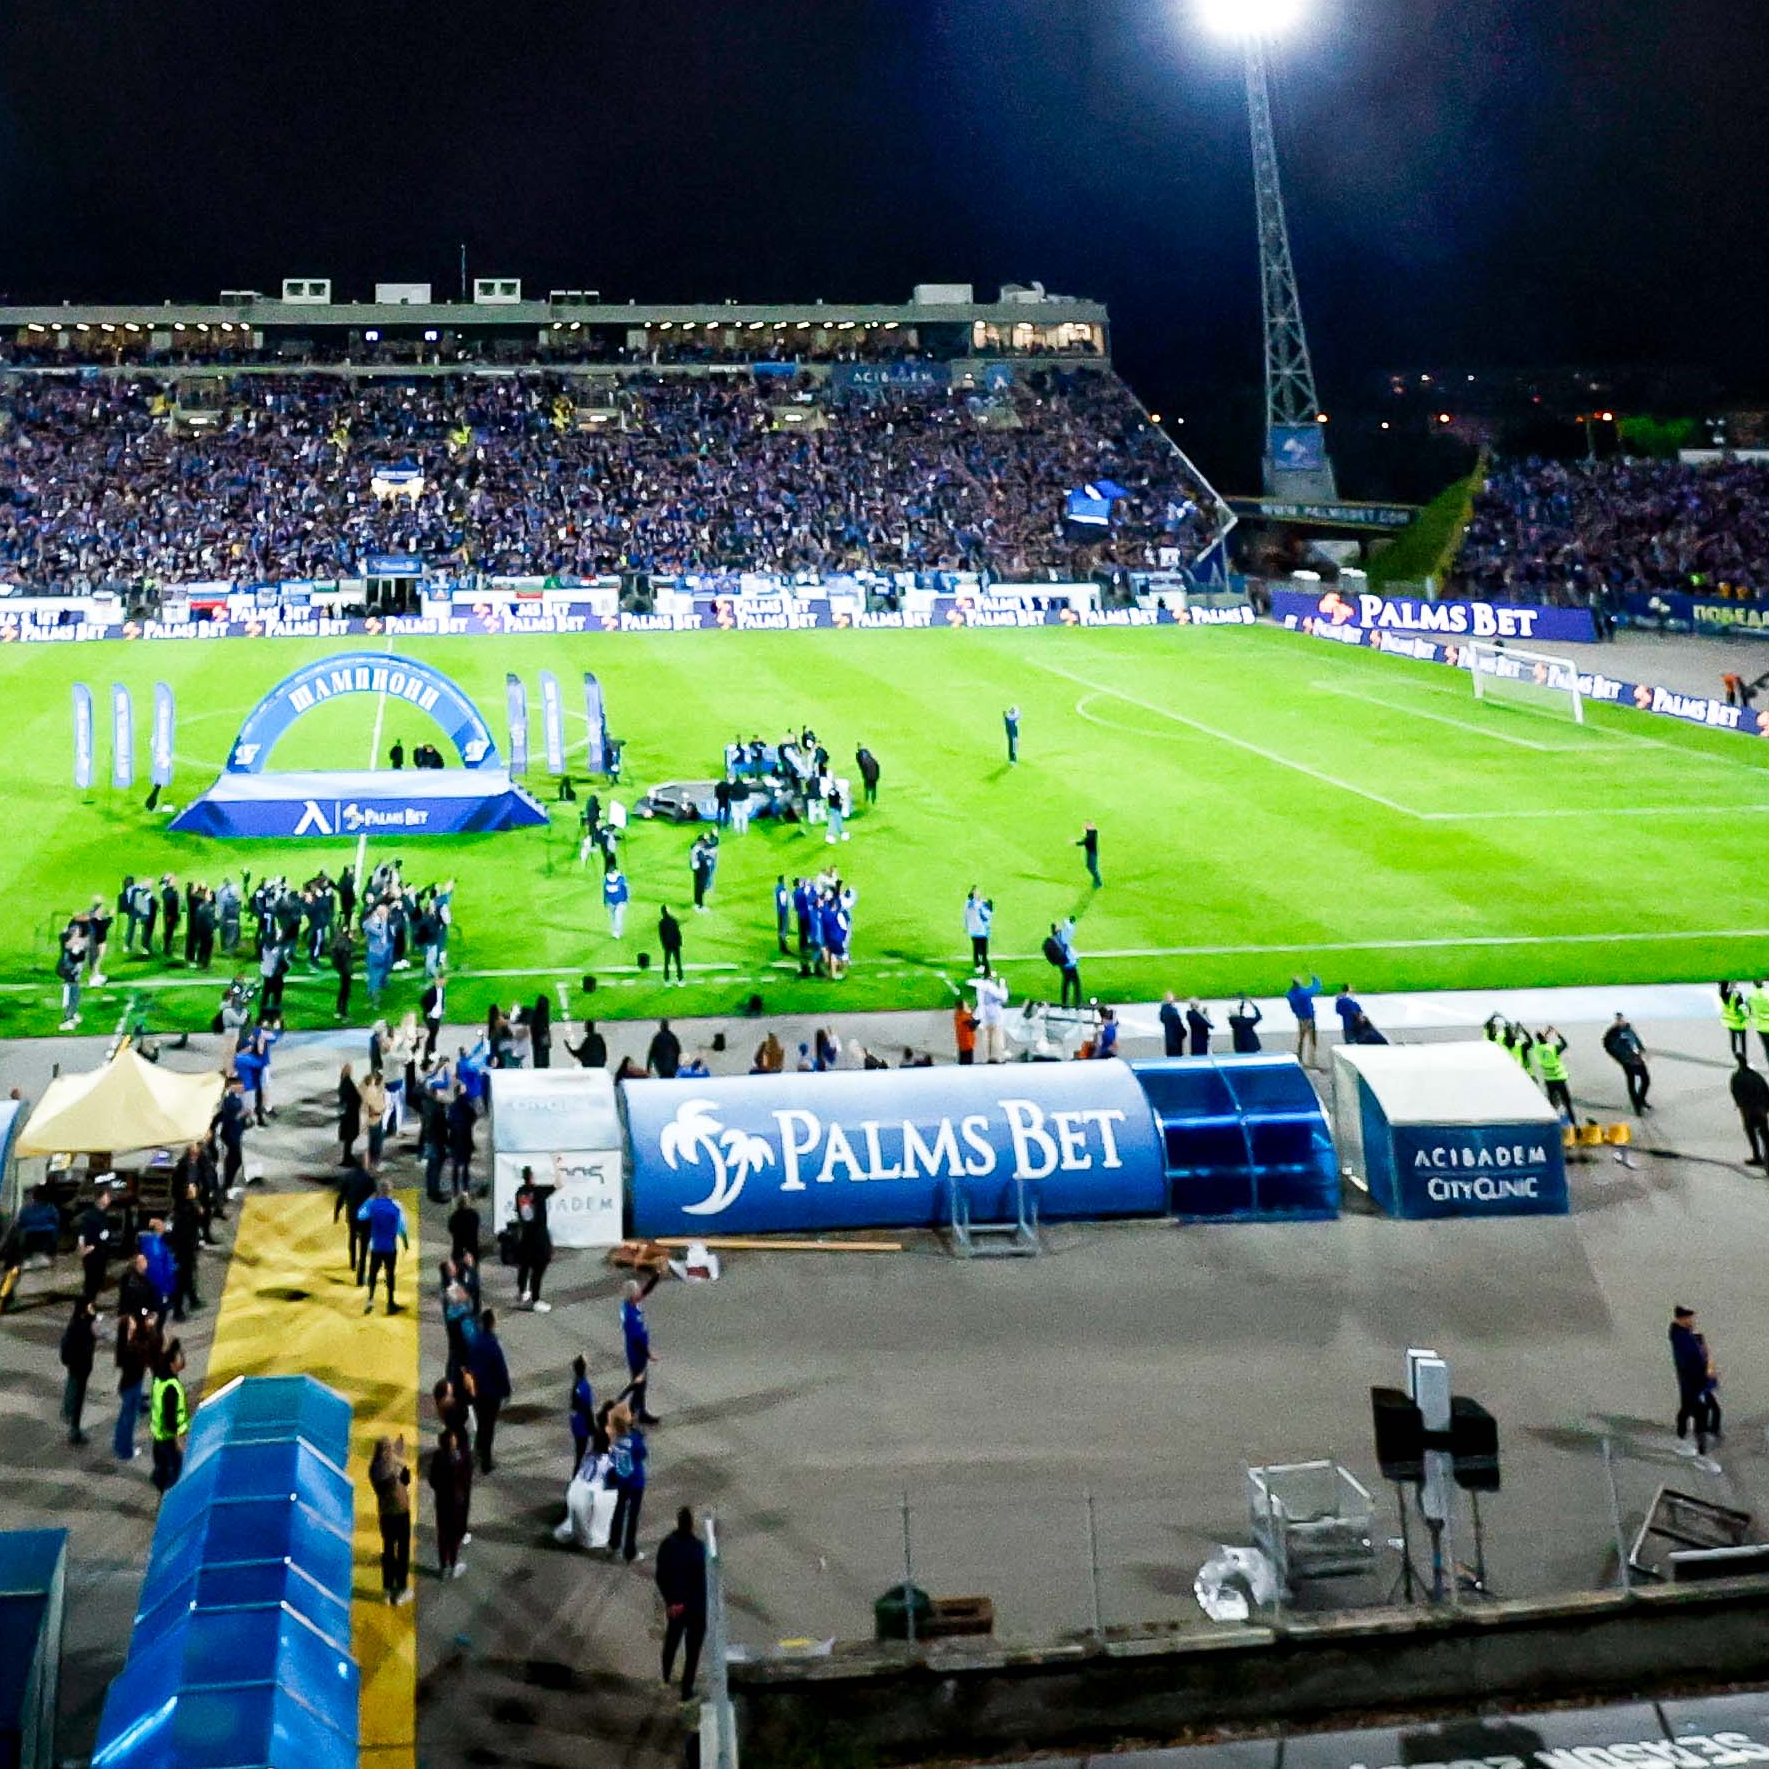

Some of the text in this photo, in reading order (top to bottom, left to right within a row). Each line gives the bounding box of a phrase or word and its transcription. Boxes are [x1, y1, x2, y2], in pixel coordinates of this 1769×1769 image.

[1358, 594, 1539, 637] PALMS BET
[1651, 685, 1742, 729] PALMS BET
[364, 807, 430, 827] PALMS BET
[771, 1097, 1126, 1193] PALMS BET
[1413, 1144, 1548, 1169] ACIBADEM
